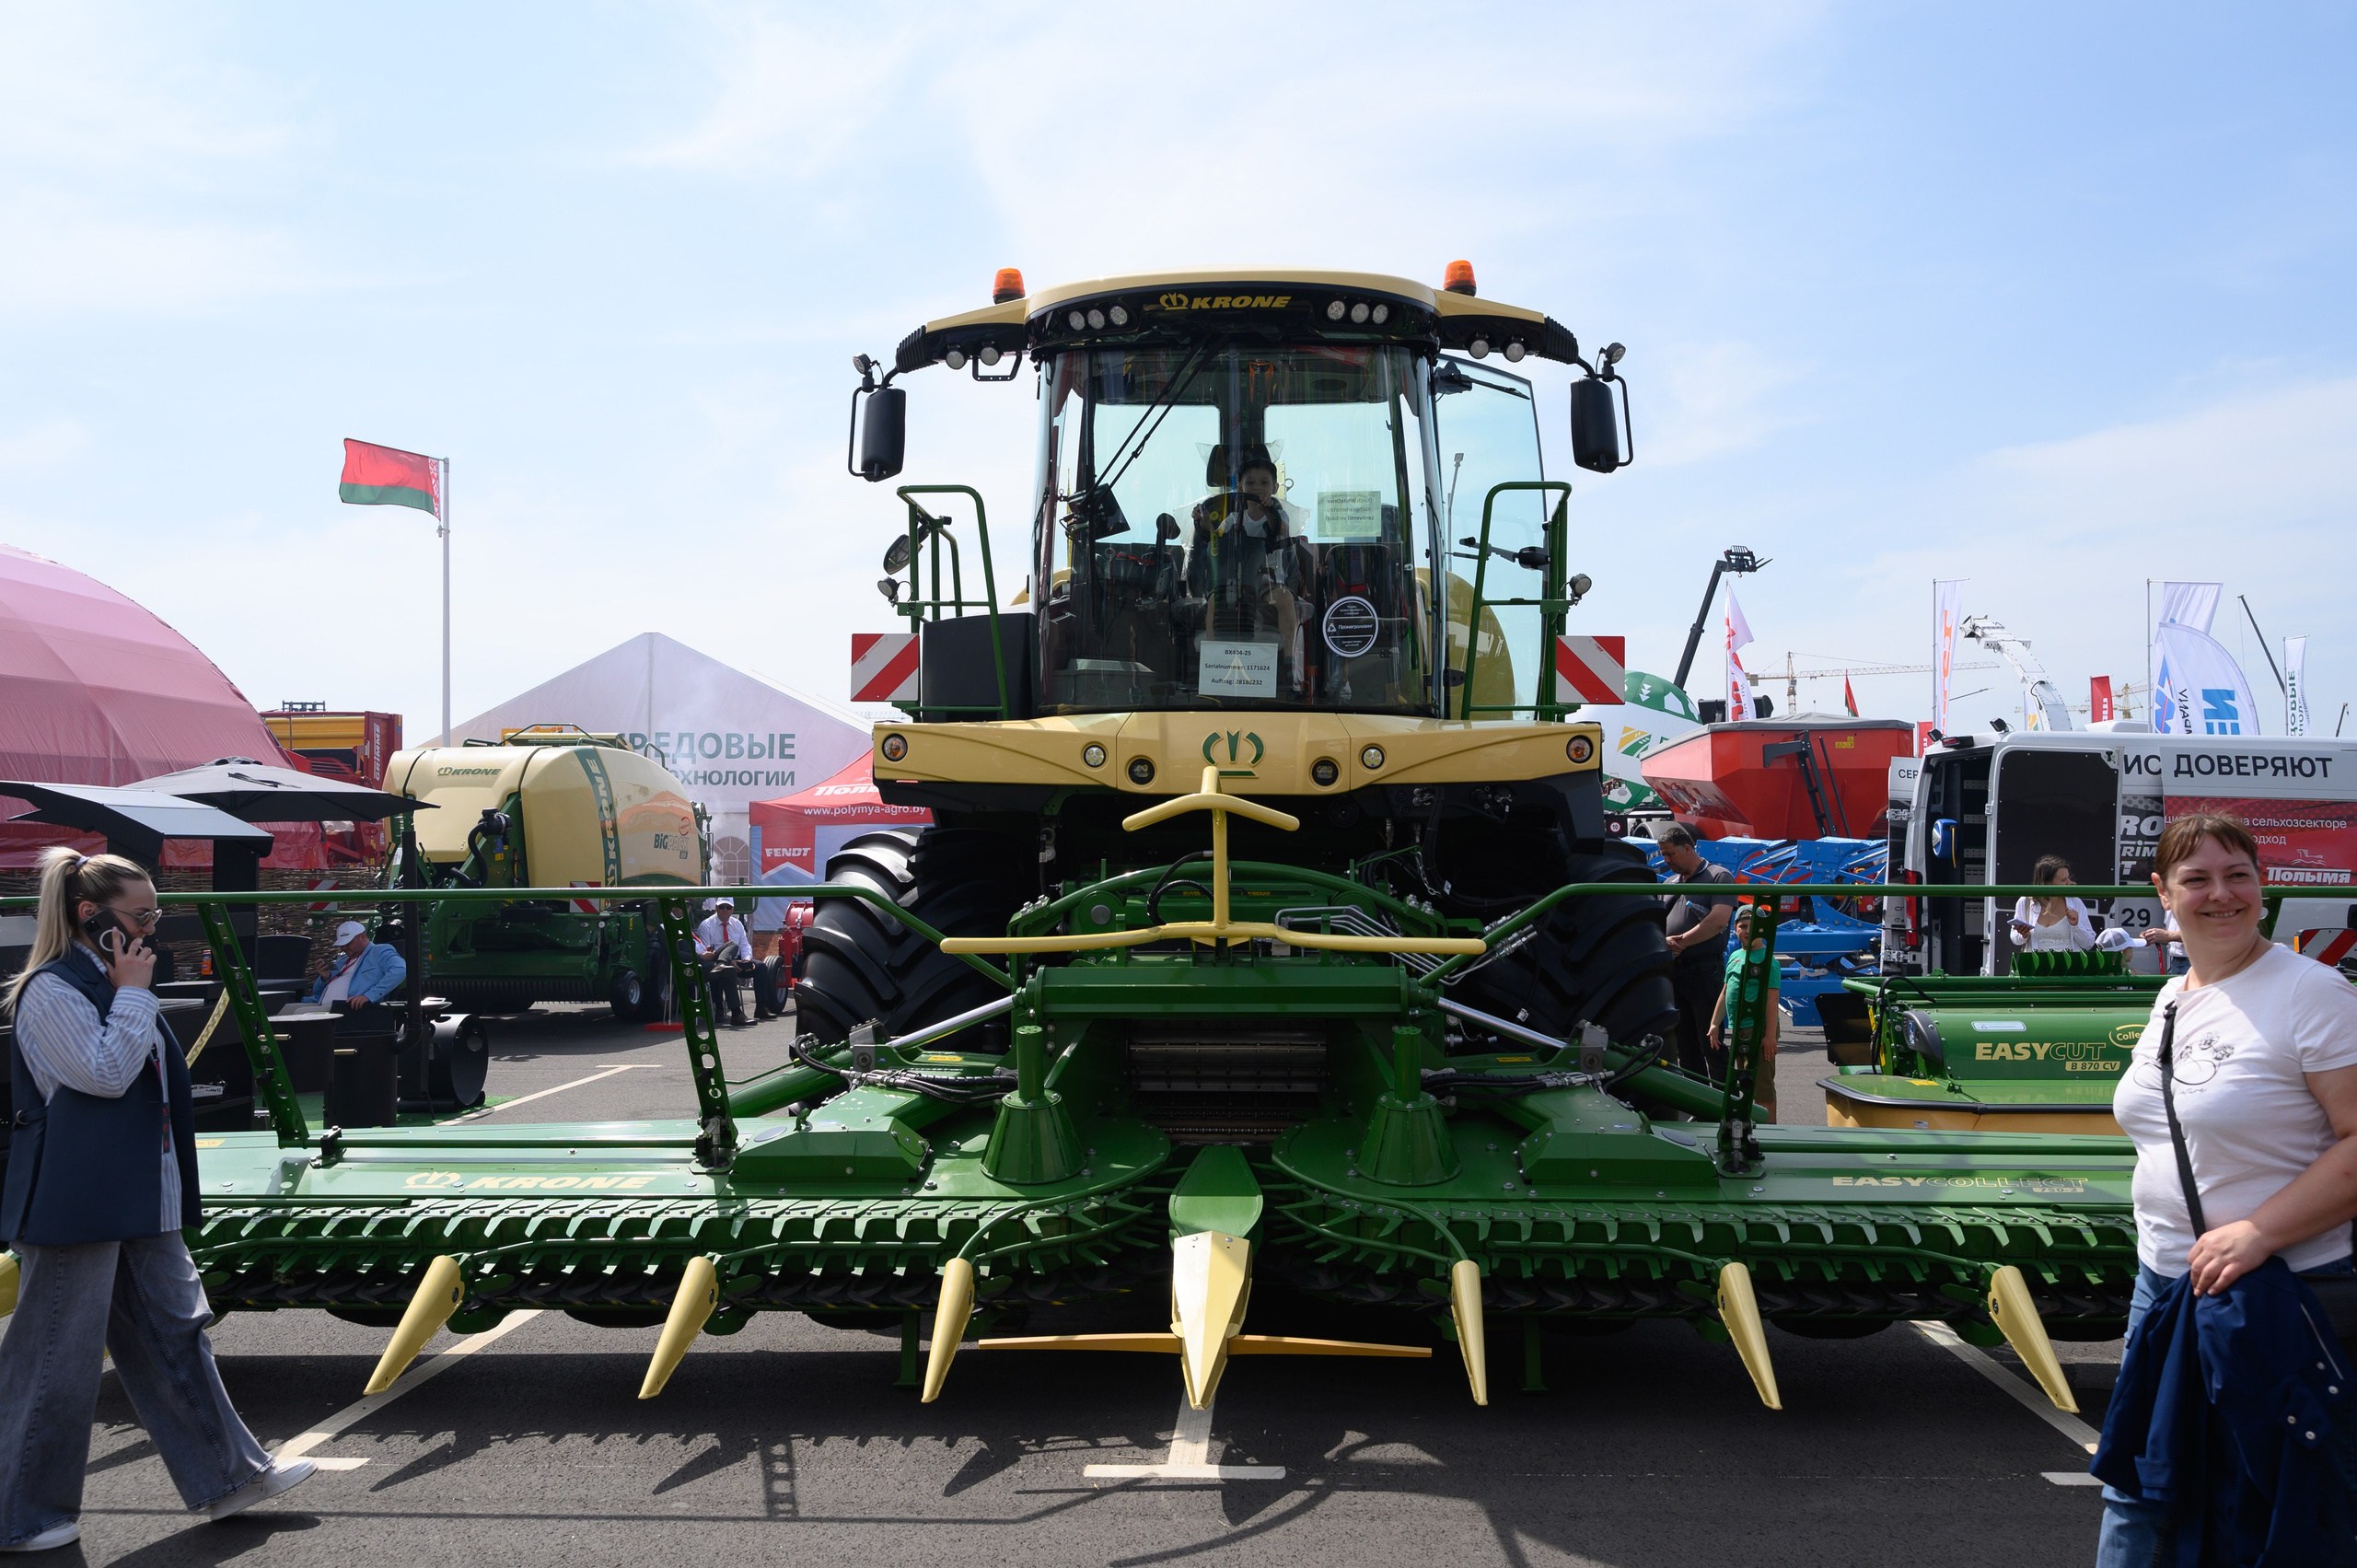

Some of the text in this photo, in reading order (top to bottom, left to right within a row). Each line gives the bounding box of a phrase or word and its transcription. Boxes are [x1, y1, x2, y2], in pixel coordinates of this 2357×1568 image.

[1191, 296, 1292, 309] KRONE
[626, 732, 796, 764] РЕДОВЫЕ
[451, 767, 502, 775] KRONE
[2174, 753, 2333, 779] ДОВЕРЯЮТ
[586, 758, 617, 860] KRONE
[804, 805, 926, 817] www.polymya-agro.by
[2252, 817, 2347, 830] сельхозсекторе
[764, 848, 811, 857] FENDT
[2116, 1030, 2143, 1041] Colle
[1975, 1042, 2107, 1061] EASYCUT
[2081, 1062, 2099, 1070] 870
[465, 1176, 658, 1190] KRONE
[1832, 1177, 2089, 1188] EASYCOLLECT
